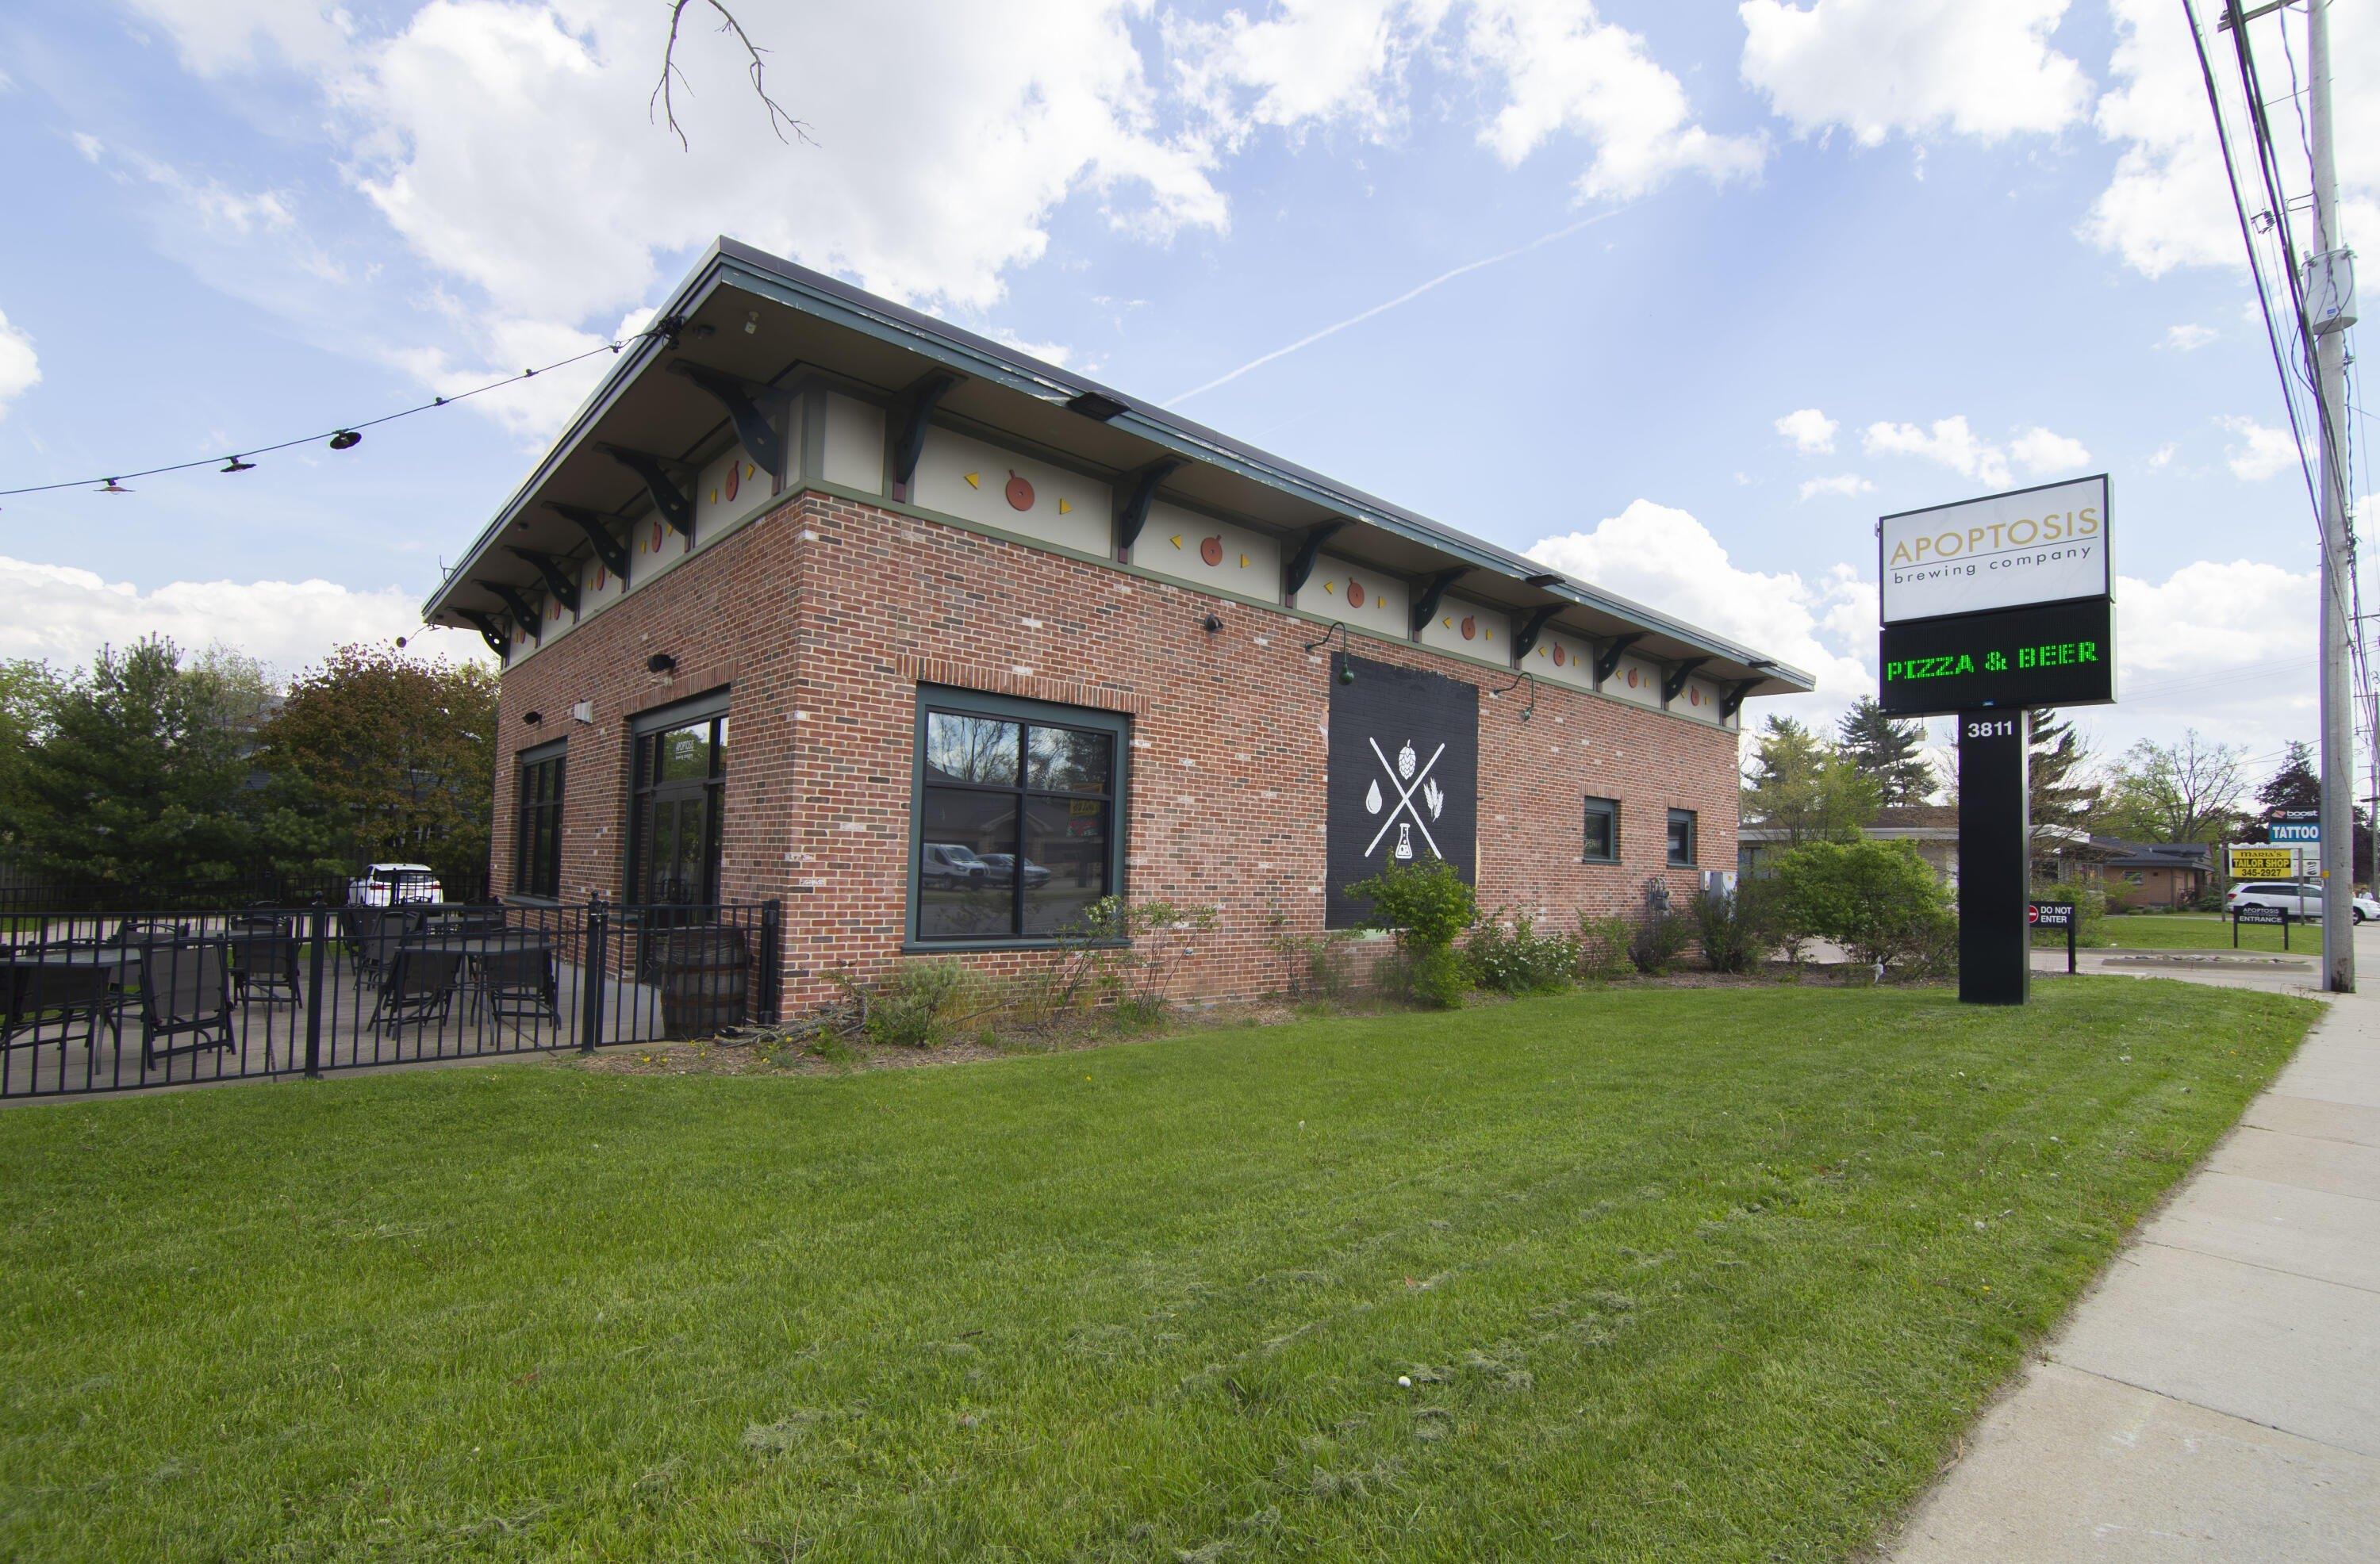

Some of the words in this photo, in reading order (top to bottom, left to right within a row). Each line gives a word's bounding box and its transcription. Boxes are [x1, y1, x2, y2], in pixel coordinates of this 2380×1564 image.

[1890, 508, 2098, 565] APOPTOSIS
[1894, 564, 1976, 584] brewing
[1990, 546, 2092, 570] company
[1887, 654, 1975, 680] PIZZA
[1985, 651, 2008, 672] &
[2019, 641, 2099, 669] BEER
[1967, 721, 2013, 738] 3811
[2272, 826, 2319, 839] TATTOO
[2233, 859, 2263, 868] TAILOR
[2266, 859, 2290, 868] SHOP
